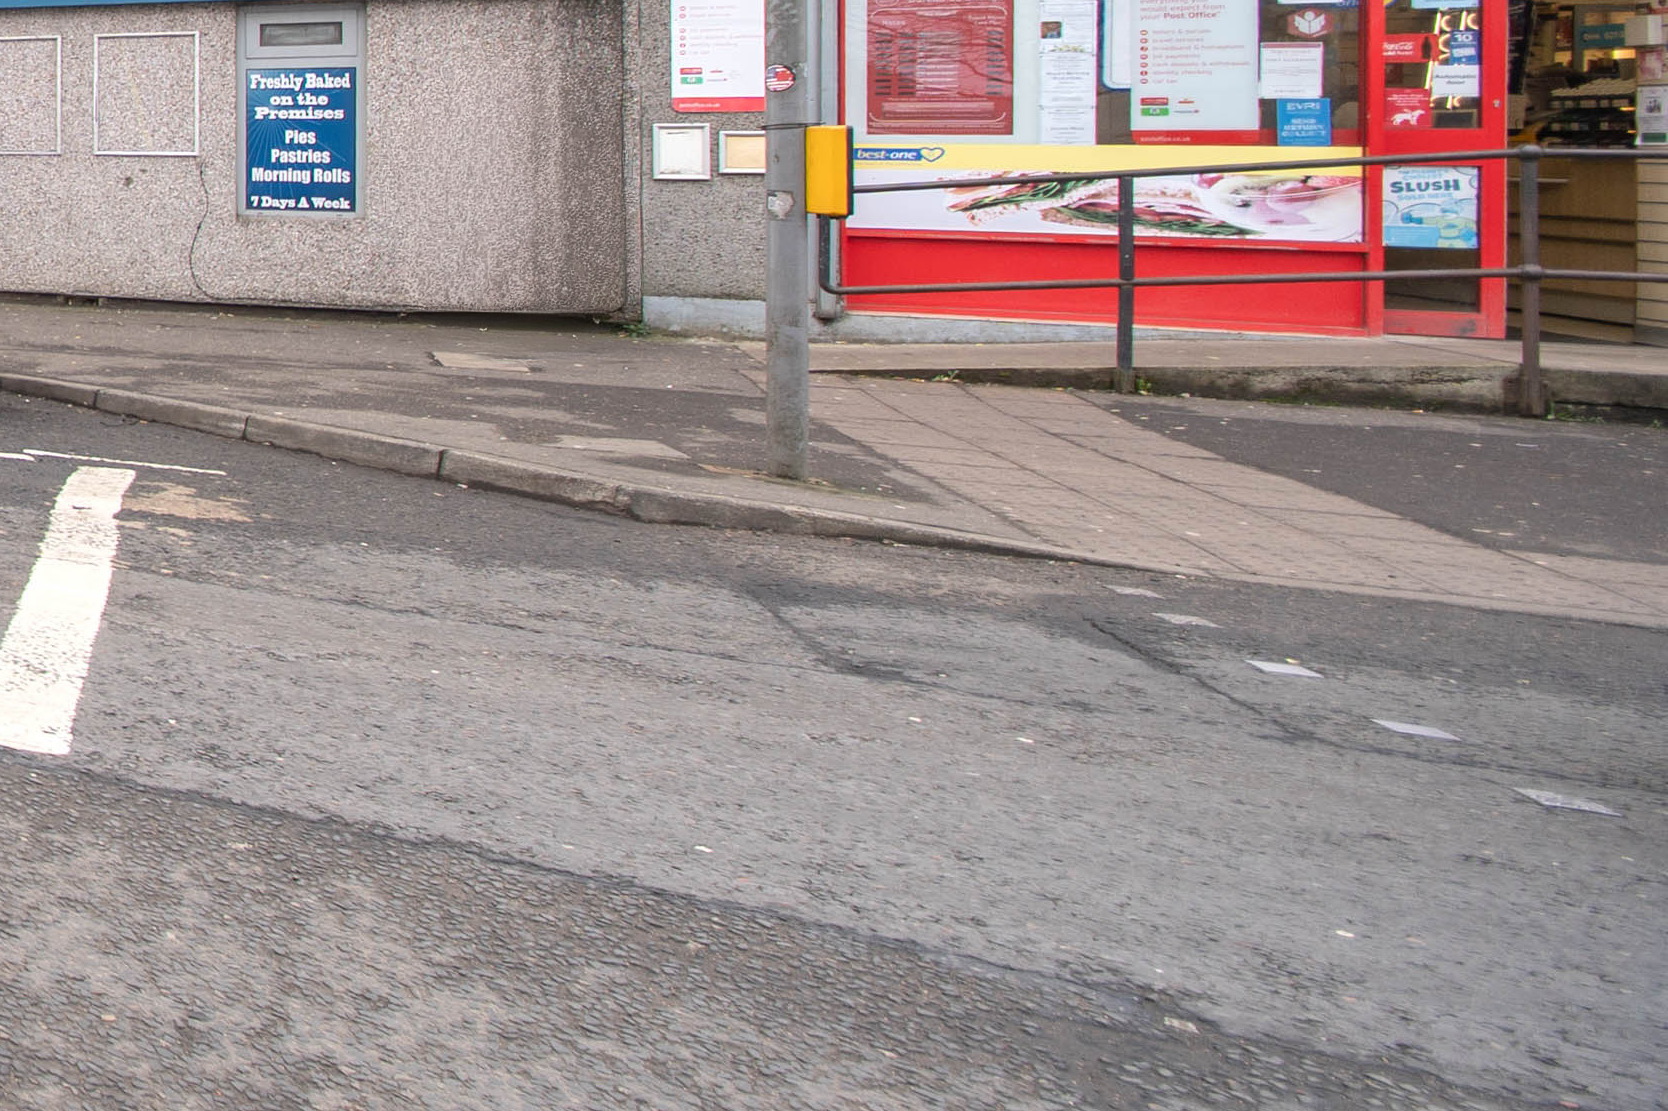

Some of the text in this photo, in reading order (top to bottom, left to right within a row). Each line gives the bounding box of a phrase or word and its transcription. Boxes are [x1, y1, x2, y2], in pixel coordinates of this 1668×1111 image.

[250, 72, 351, 91] Freshly Baked
[270, 92, 329, 106] on the
[254, 106, 345, 119] Premises
[285, 129, 317, 145] Pies
[271, 148, 331, 164] Pastries
[857, 149, 918, 160] best-one
[251, 167, 351, 184] Morning Rolls
[1390, 179, 1461, 194] SLUSH
[251, 195, 351, 210] 7 Days A Week
